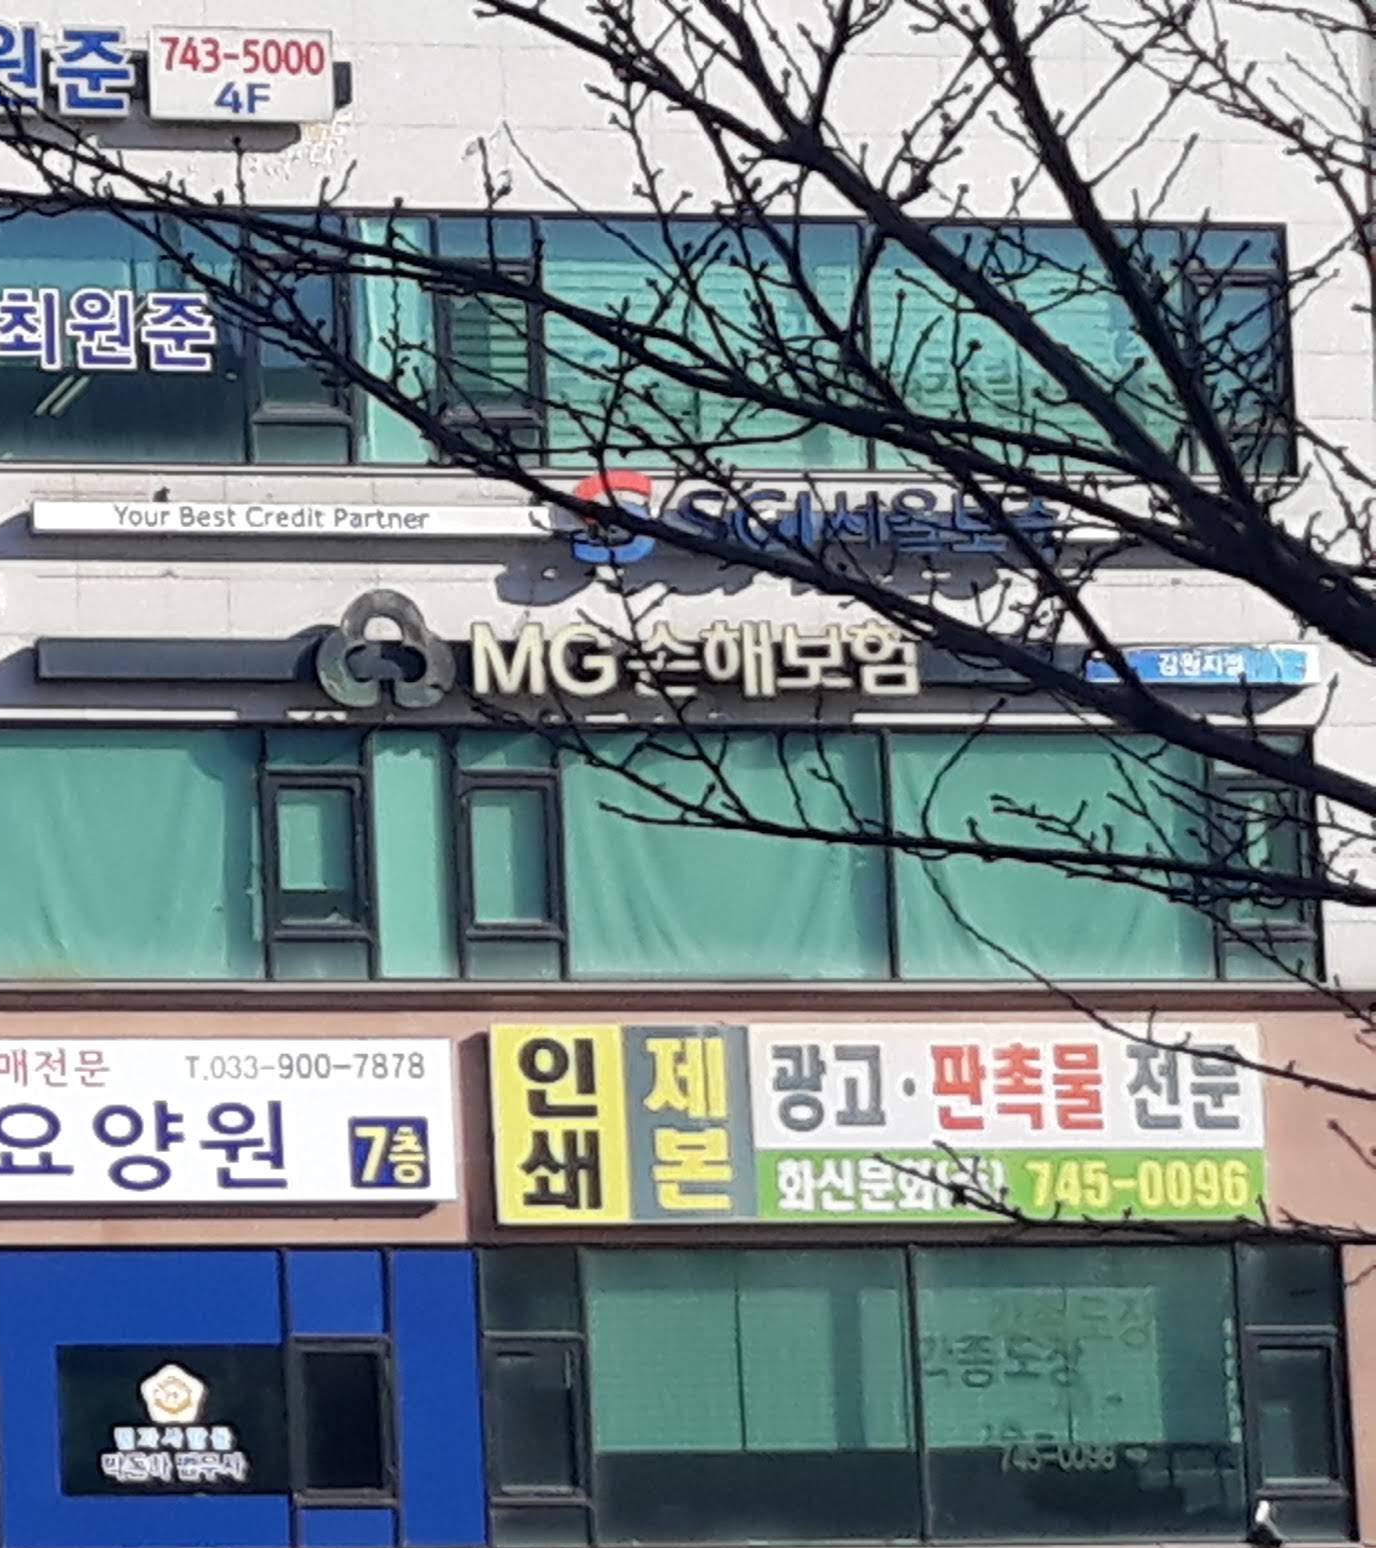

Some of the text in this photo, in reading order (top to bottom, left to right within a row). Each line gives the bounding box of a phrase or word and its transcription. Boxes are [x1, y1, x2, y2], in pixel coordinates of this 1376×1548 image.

[160, 35, 325, 76] 743-5000
[214, 80, 272, 114] 4F
[114, 504, 431, 532] Your Best Credit Partner
[1126, 1040, 1243, 1131] 전문
[352, 1126, 430, 1185] 7층
[1024, 1157, 1251, 1213] 745-0096
